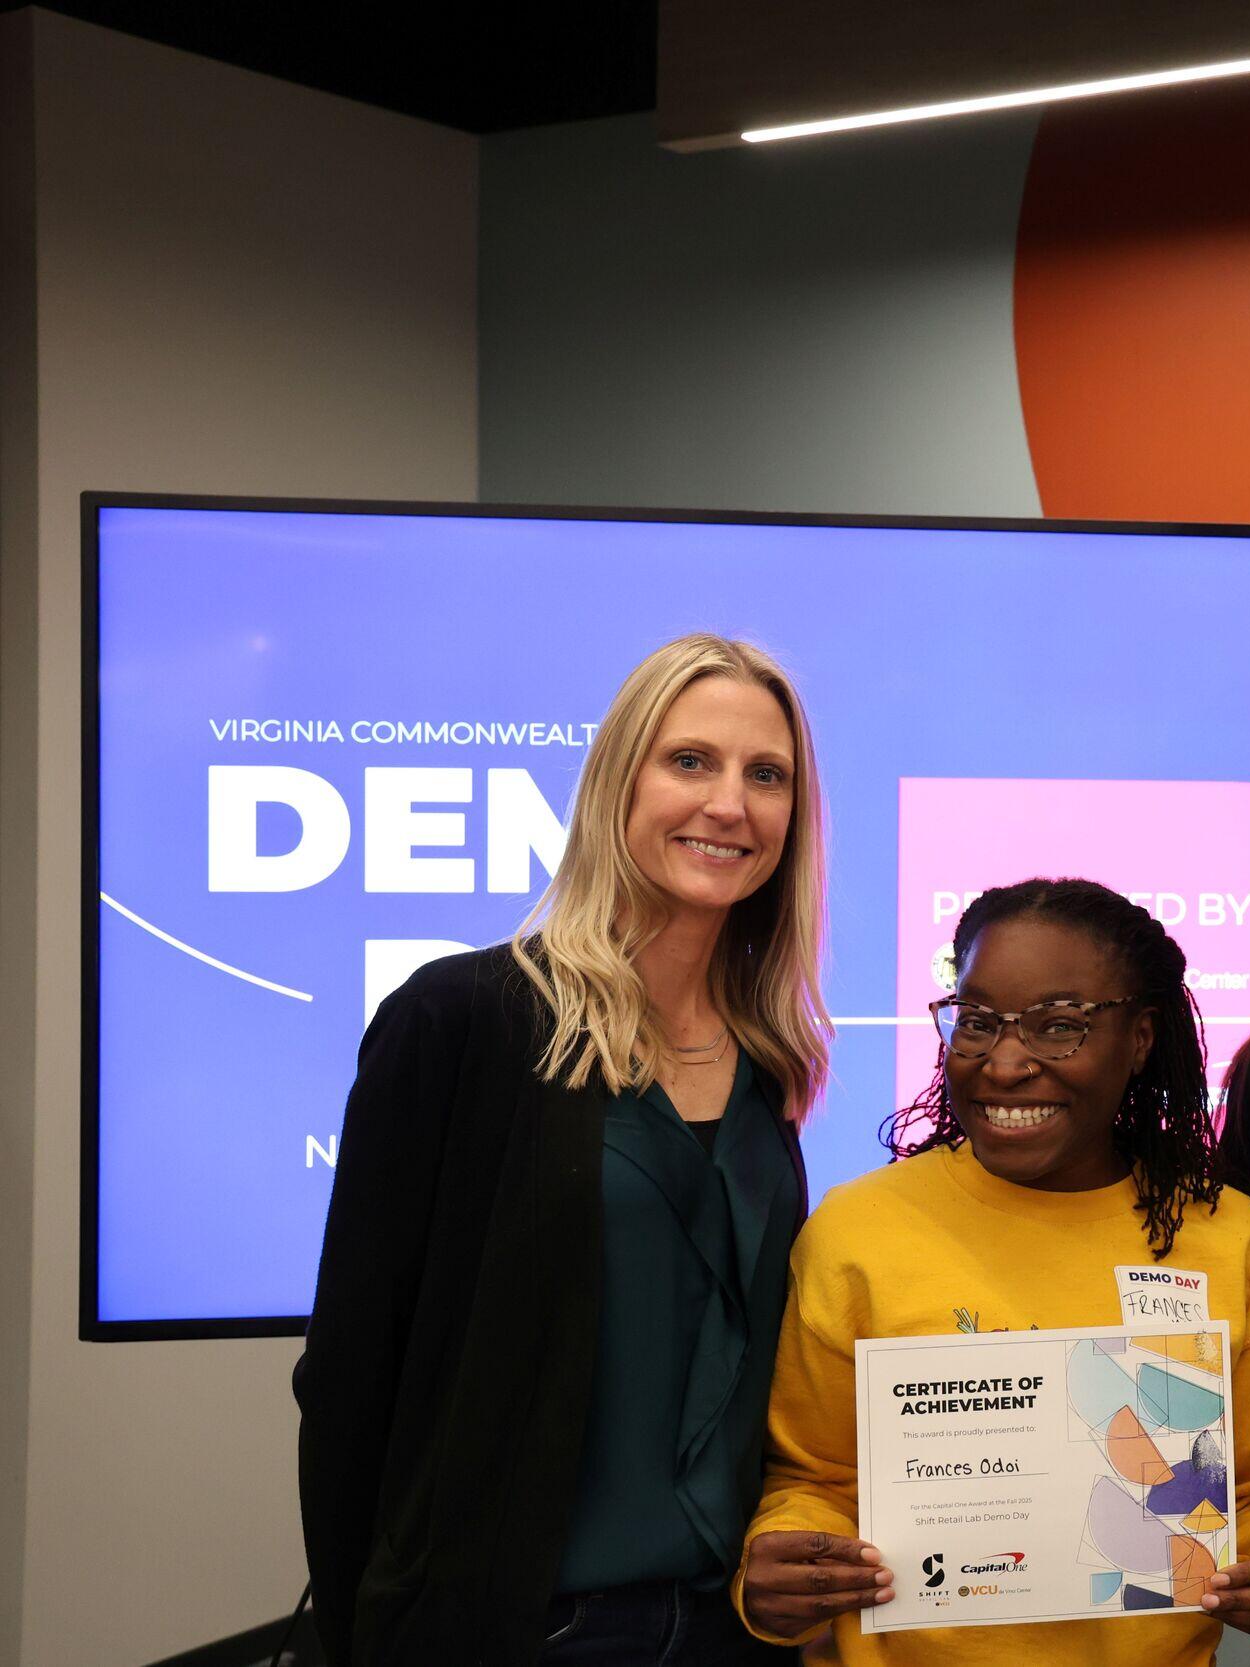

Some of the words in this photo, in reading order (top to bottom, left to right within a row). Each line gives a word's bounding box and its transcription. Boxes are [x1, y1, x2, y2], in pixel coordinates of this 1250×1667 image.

[209, 718, 345, 743] VIRGINIA
[350, 720, 599, 747] COMMONWEALT
[1129, 1272, 1171, 1283] DEMO
[1175, 1276, 1200, 1290] DAY
[1123, 1289, 1204, 1321] FRANCES
[893, 1378, 1013, 1397] CERTIFICATE
[1018, 1376, 1044, 1391] OF
[900, 1395, 1037, 1415] ACHIEVEMENT
[903, 1431, 919, 1439] This
[920, 1430, 944, 1438] award
[954, 1427, 984, 1438] proudly
[985, 1425, 1025, 1435] presented
[906, 1458, 973, 1478] Frances
[980, 1457, 1020, 1474] Odoi
[932, 1502, 953, 1510] Capital
[915, 1517, 935, 1526] Shift
[938, 1515, 963, 1524] Retail
[965, 1514, 981, 1523] Lab
[983, 1513, 1011, 1522] Demo
[1012, 1511, 1030, 1520] Day
[919, 1590, 950, 1598] SHIFT
[970, 1585, 998, 1596] VCU
